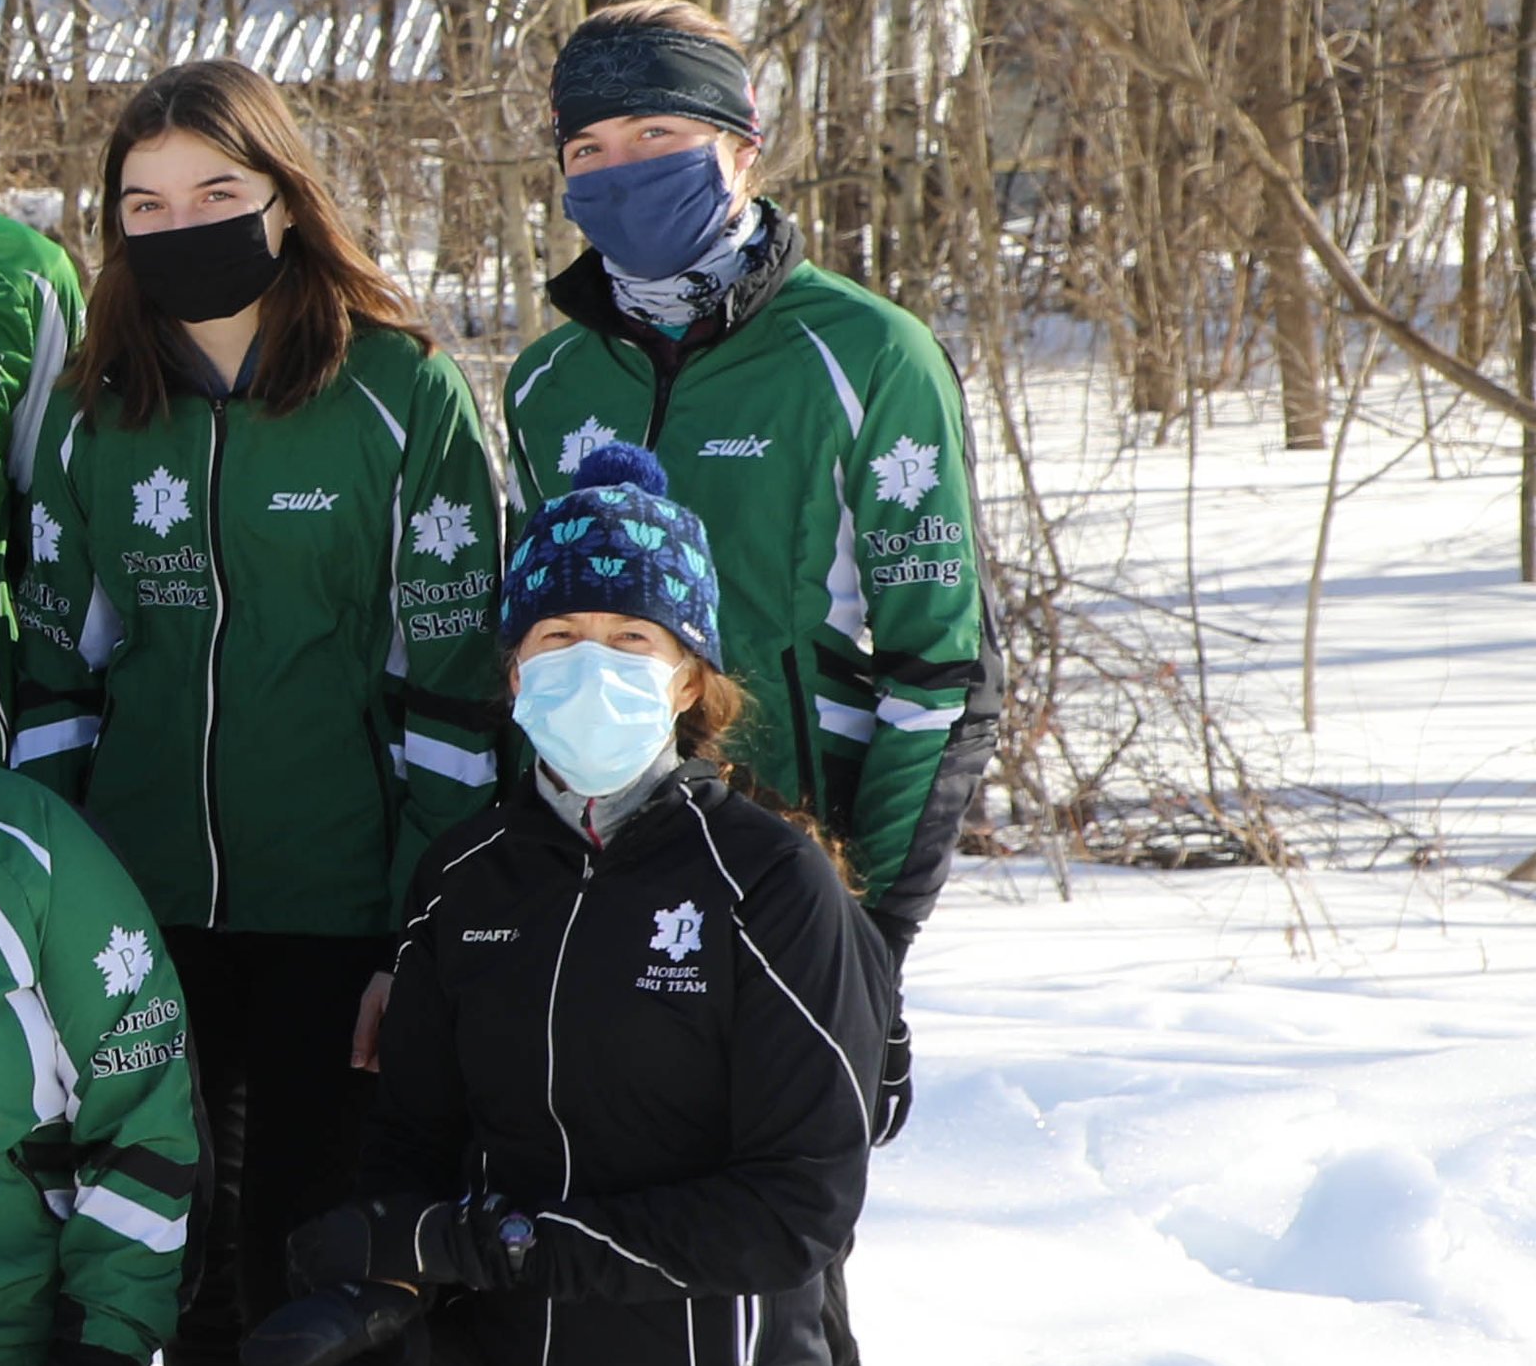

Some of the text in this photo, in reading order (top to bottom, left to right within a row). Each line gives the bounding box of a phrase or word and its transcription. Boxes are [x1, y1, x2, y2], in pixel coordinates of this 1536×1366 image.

[698, 434, 772, 458] swix
[899, 458, 919, 490] P
[153, 488, 171, 516] P
[268, 487, 339, 512] swix
[436, 514, 453, 541] P
[863, 515, 962, 557] Nodic
[462, 929, 512, 944] CRAFT
[672, 919, 695, 944] P
[120, 946, 136, 976] P
[646, 964, 700, 979] NORDIC
[636, 977, 708, 993] SKI TEAM
[100, 996, 179, 1042] ordic
[92, 1031, 185, 1077] Skiing
